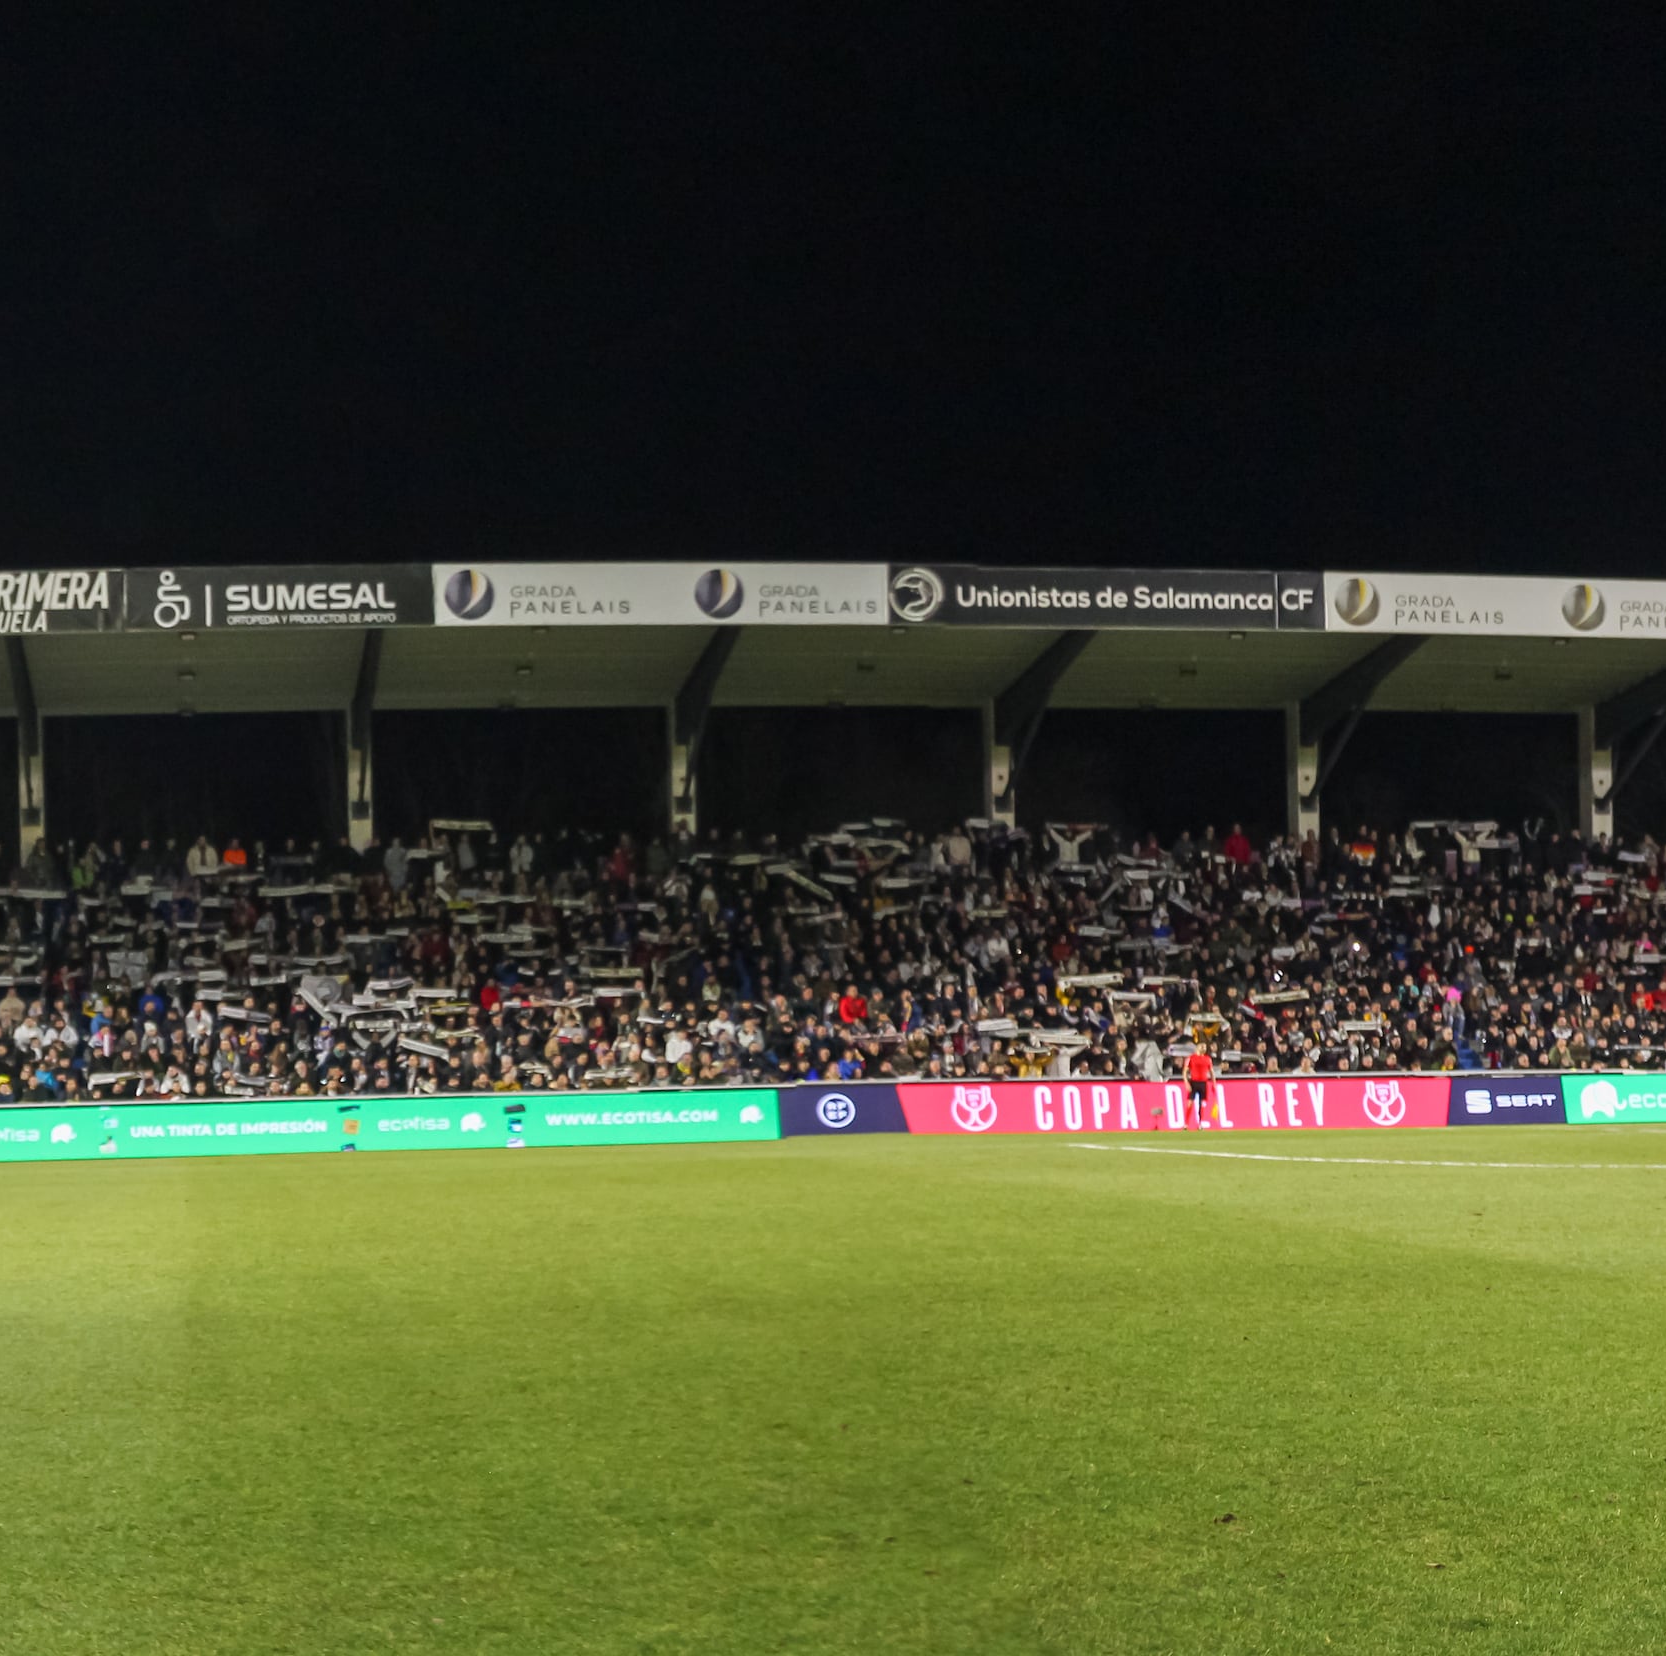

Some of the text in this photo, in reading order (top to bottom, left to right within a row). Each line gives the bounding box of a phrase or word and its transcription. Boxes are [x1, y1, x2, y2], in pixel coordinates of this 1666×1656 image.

[226, 583, 396, 611] SUMESAL
[510, 585, 576, 598] GRADA
[759, 585, 819, 598] GRADA
[955, 585, 1313, 611] Unionistas de Salamanca CF
[510, 600, 631, 618] PANELAIS
[758, 600, 877, 618] PANELAIS
[1395, 594, 1455, 608] GRADA
[226, 612, 396, 626] ORTOPEDIA Y PRODUCTOS DE APOYO
[1394, 609, 1504, 626] PANELAIS
[1034, 1084, 1138, 1130] COPA
[1258, 1082, 1324, 1127] REY
[1496, 1094, 1556, 1107] SEAT
[378, 1117, 450, 1132] ecotisa
[545, 1110, 718, 1126] WWW.ECOTISA.COM
[130, 1119, 327, 1138] UNA TINTA DE IMPRESIÓN
